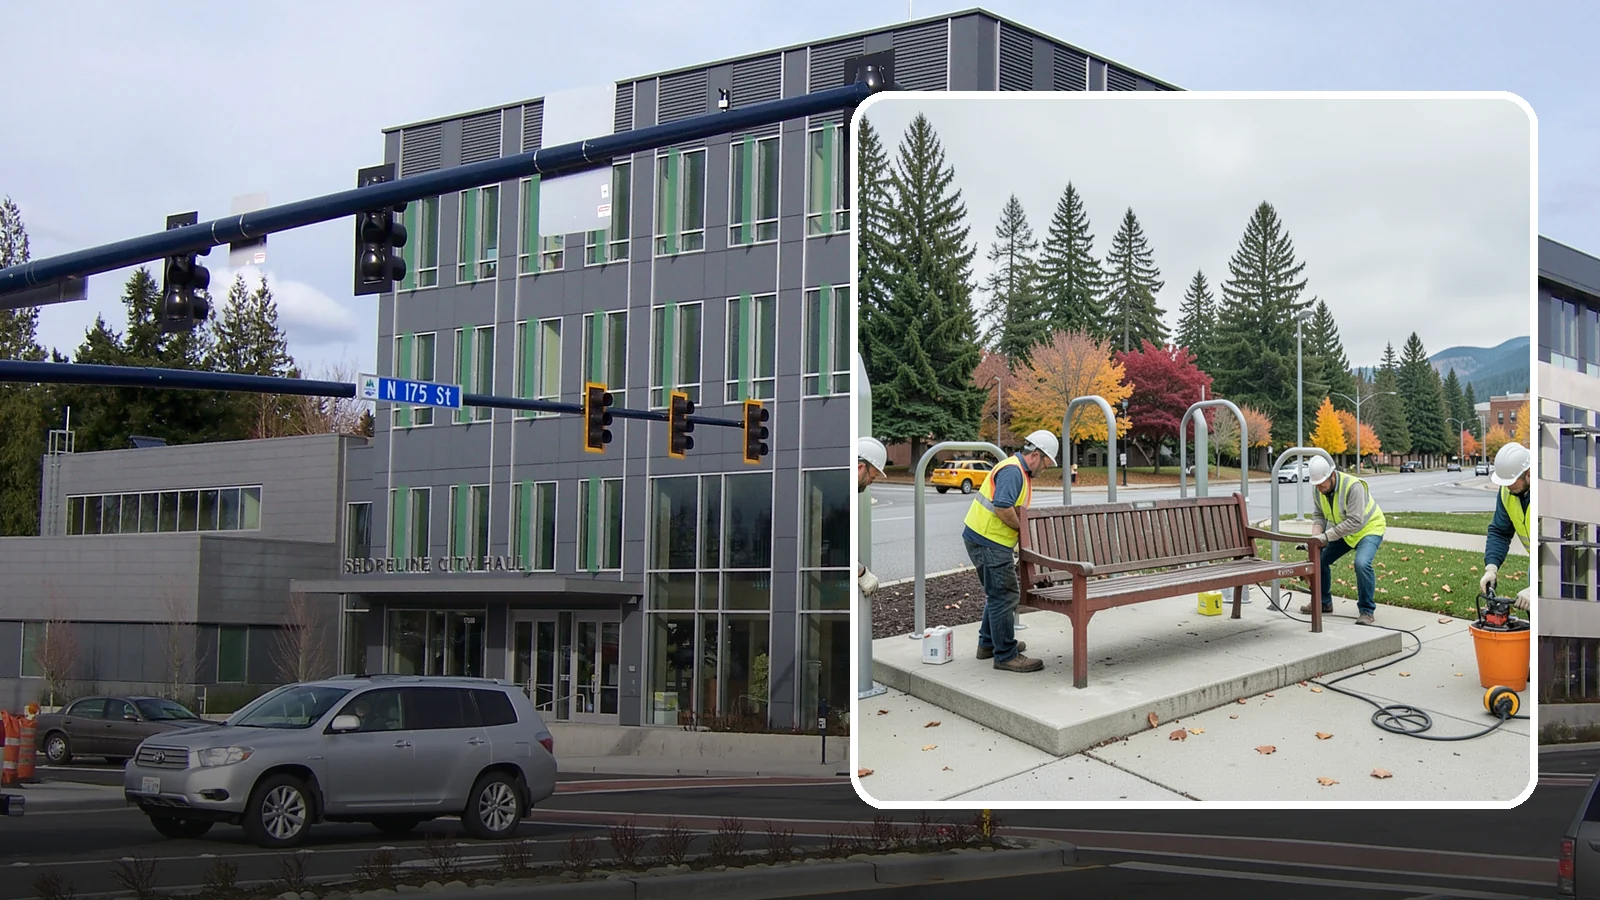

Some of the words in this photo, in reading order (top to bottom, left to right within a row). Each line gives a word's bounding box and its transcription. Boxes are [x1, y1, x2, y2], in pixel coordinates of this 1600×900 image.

[387, 380, 396, 400] N
[405, 382, 427, 403] 175
[436, 386, 451, 406] St
[344, 556, 432, 574] SHORELINE
[438, 555, 475, 572] CITY
[483, 555, 525, 572] HALL
